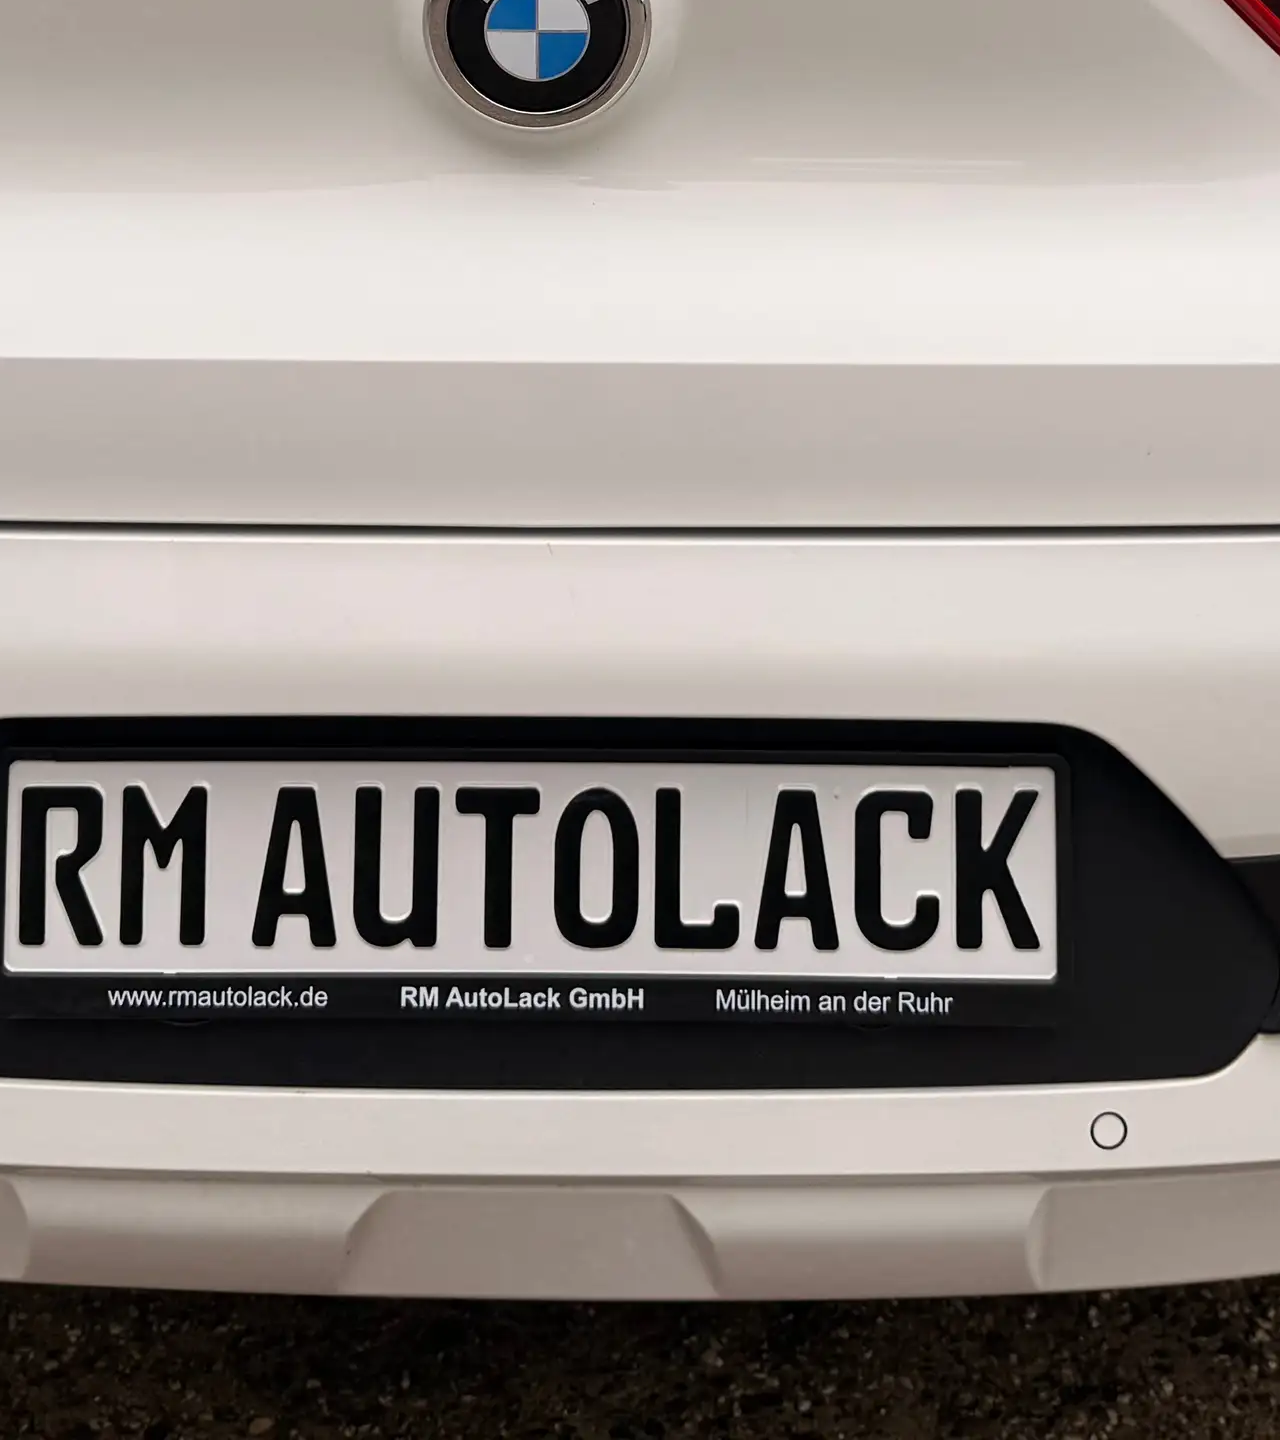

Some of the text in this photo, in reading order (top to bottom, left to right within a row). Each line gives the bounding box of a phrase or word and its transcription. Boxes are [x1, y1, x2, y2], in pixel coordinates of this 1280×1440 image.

[19, 785, 1041, 950] RM AUTOLACK
[107, 986, 328, 1008] www.rmautolack.de
[400, 986, 644, 1010] RM AutoLack GmbH
[716, 988, 954, 1014] Mülheim an der Ruhr
